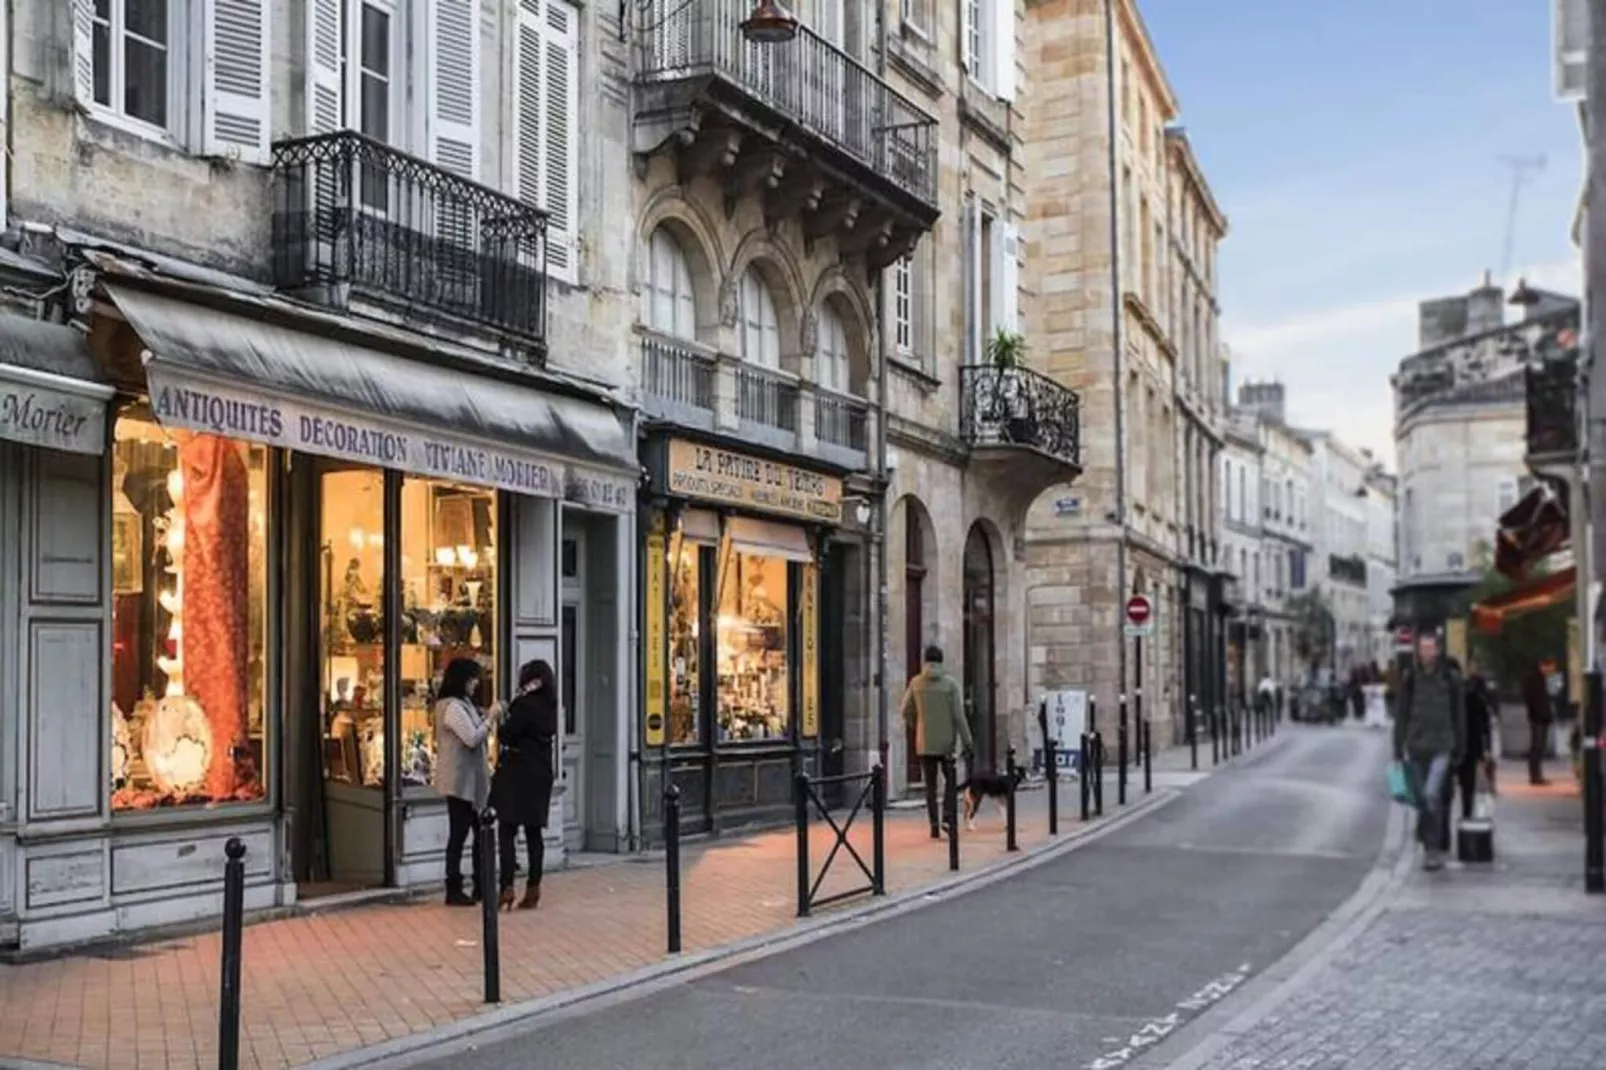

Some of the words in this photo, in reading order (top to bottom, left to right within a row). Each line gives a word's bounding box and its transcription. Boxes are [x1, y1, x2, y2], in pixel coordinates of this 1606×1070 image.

[3, 393, 87, 437] Morier
[424, 441, 486, 478] VIVIANE
[696, 447, 712, 472] LA
[766, 463, 782, 486] DU
